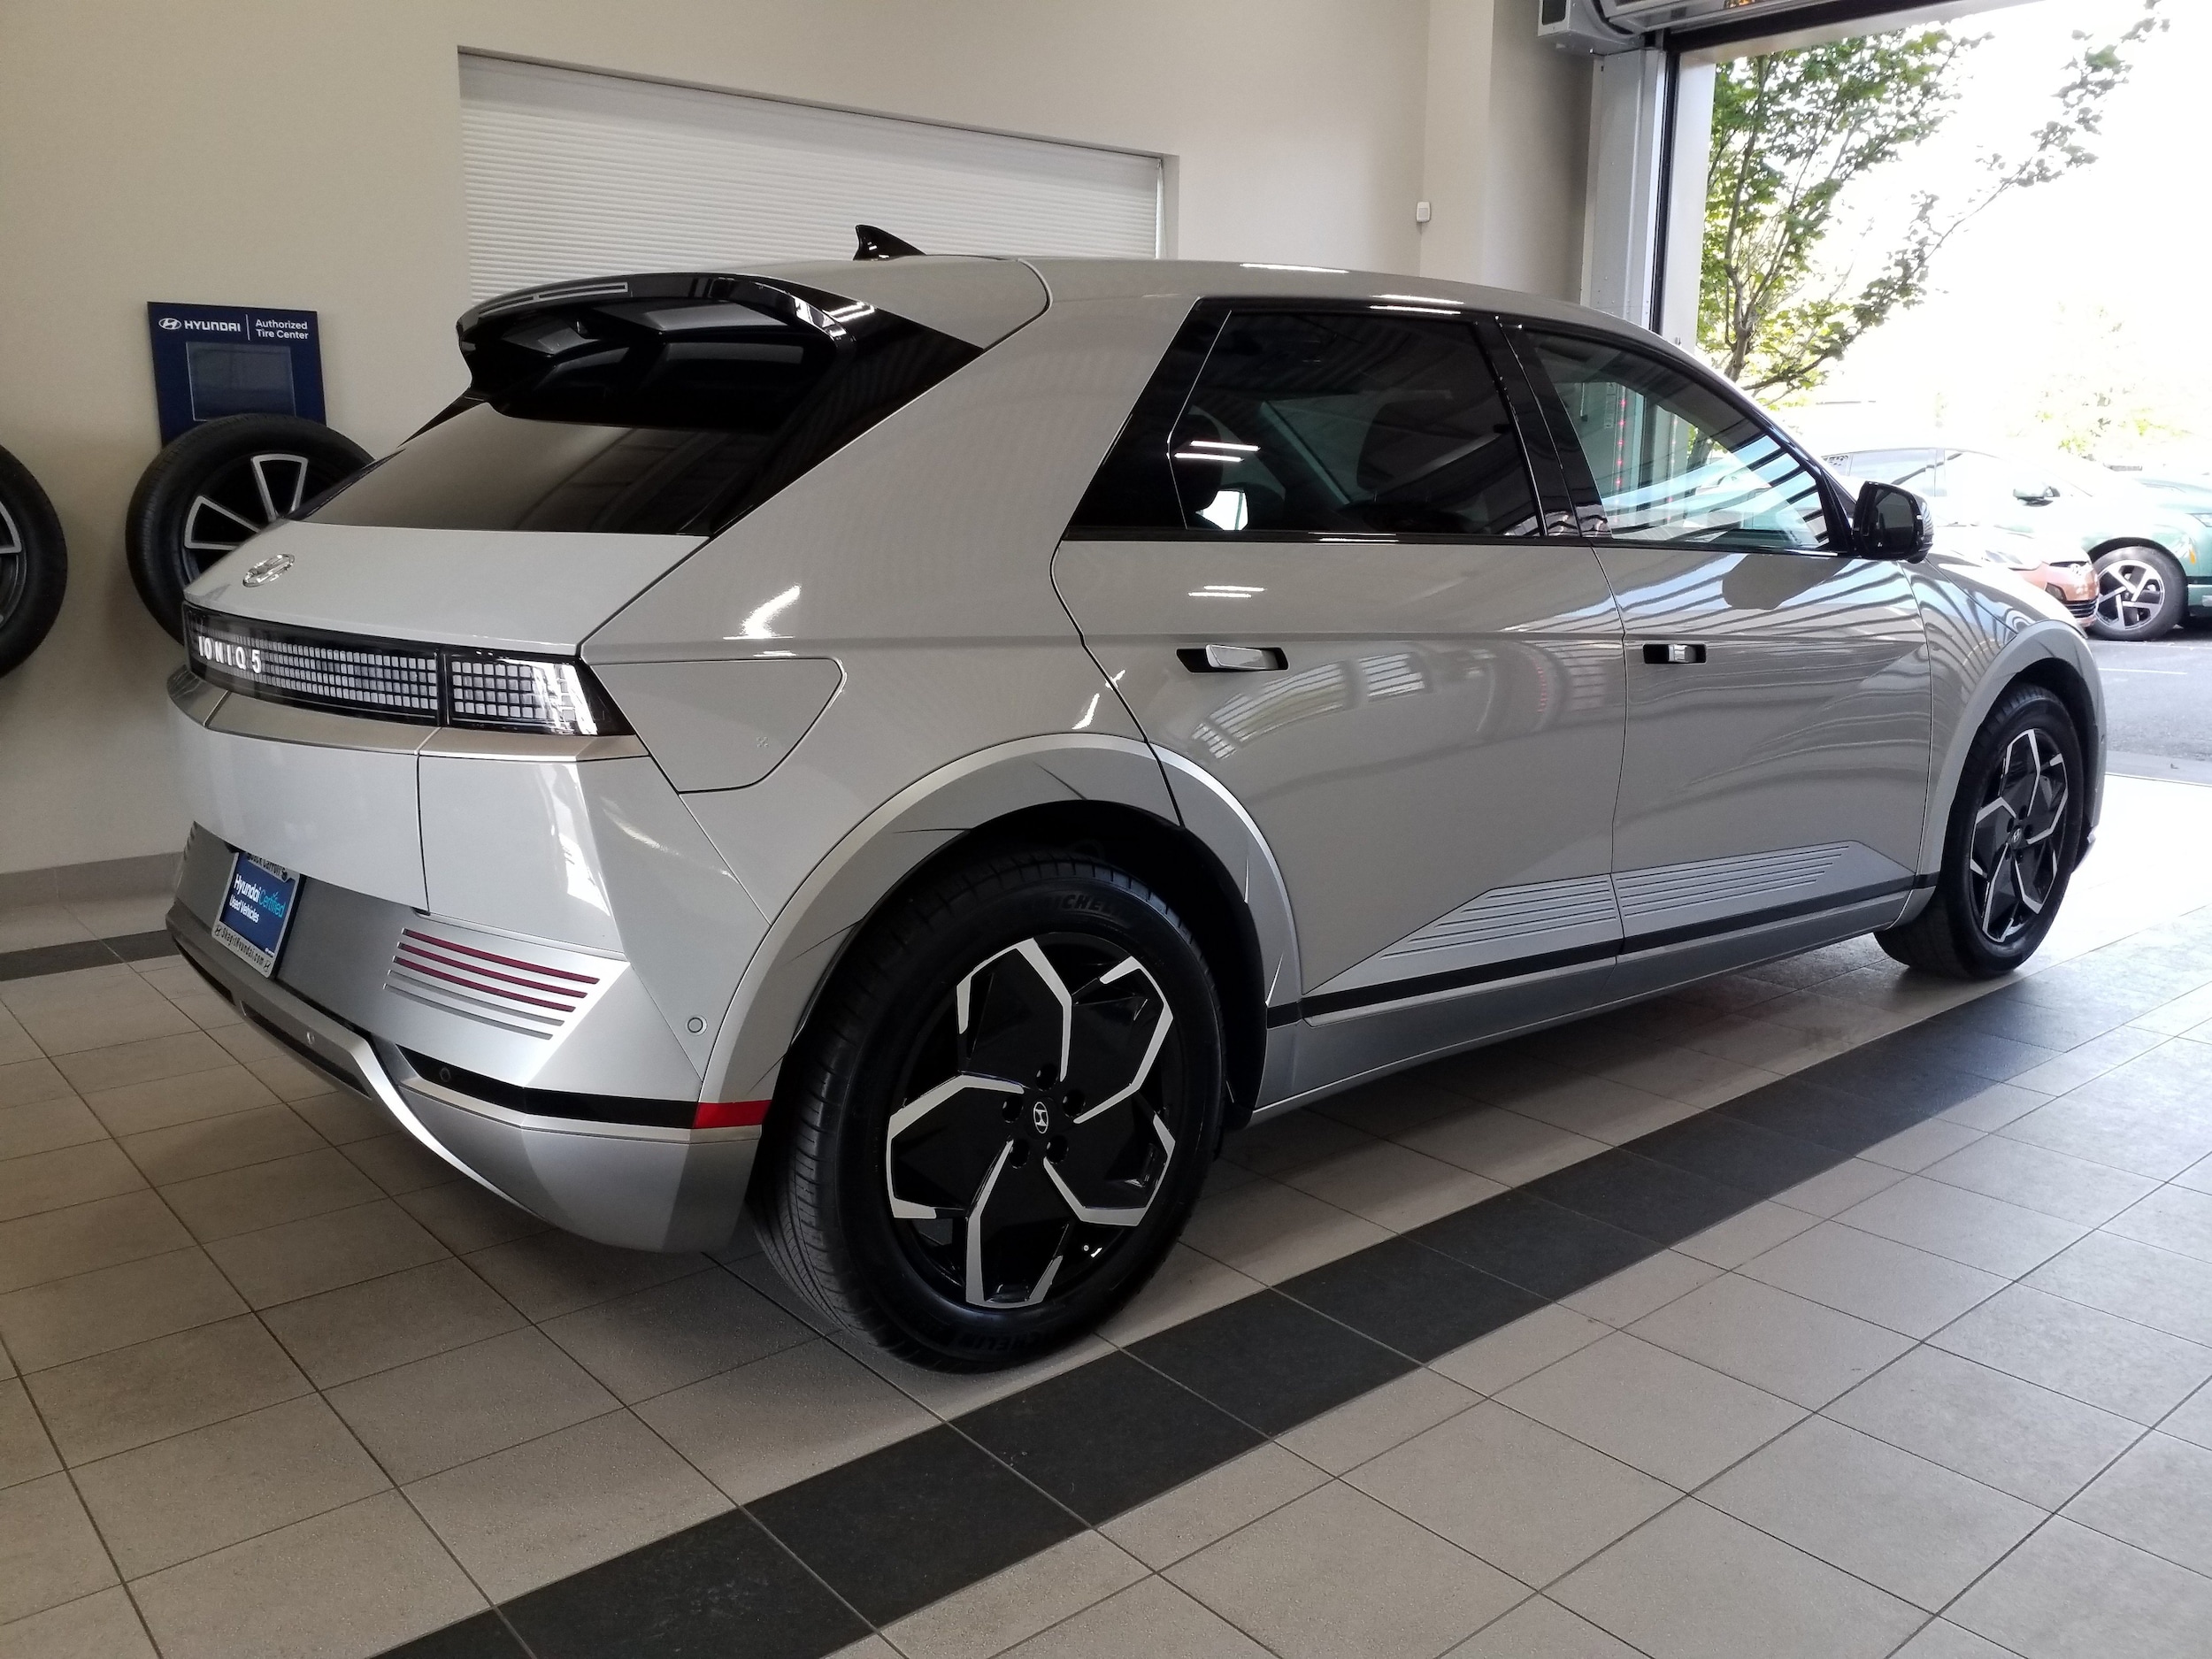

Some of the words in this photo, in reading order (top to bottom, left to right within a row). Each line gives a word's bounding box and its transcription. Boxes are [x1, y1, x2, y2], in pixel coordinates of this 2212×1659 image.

[184, 319, 242, 333] HYUNDAI
[255, 319, 308, 330] Authorized
[256, 328, 275, 338] Tire
[276, 330, 309, 340] Center
[197, 635, 247, 671] IONIQ
[250, 648, 262, 674] 5
[233, 873, 262, 902] Hyundai
[229, 894, 242, 912] Used
[240, 899, 260, 924] Vehicles
